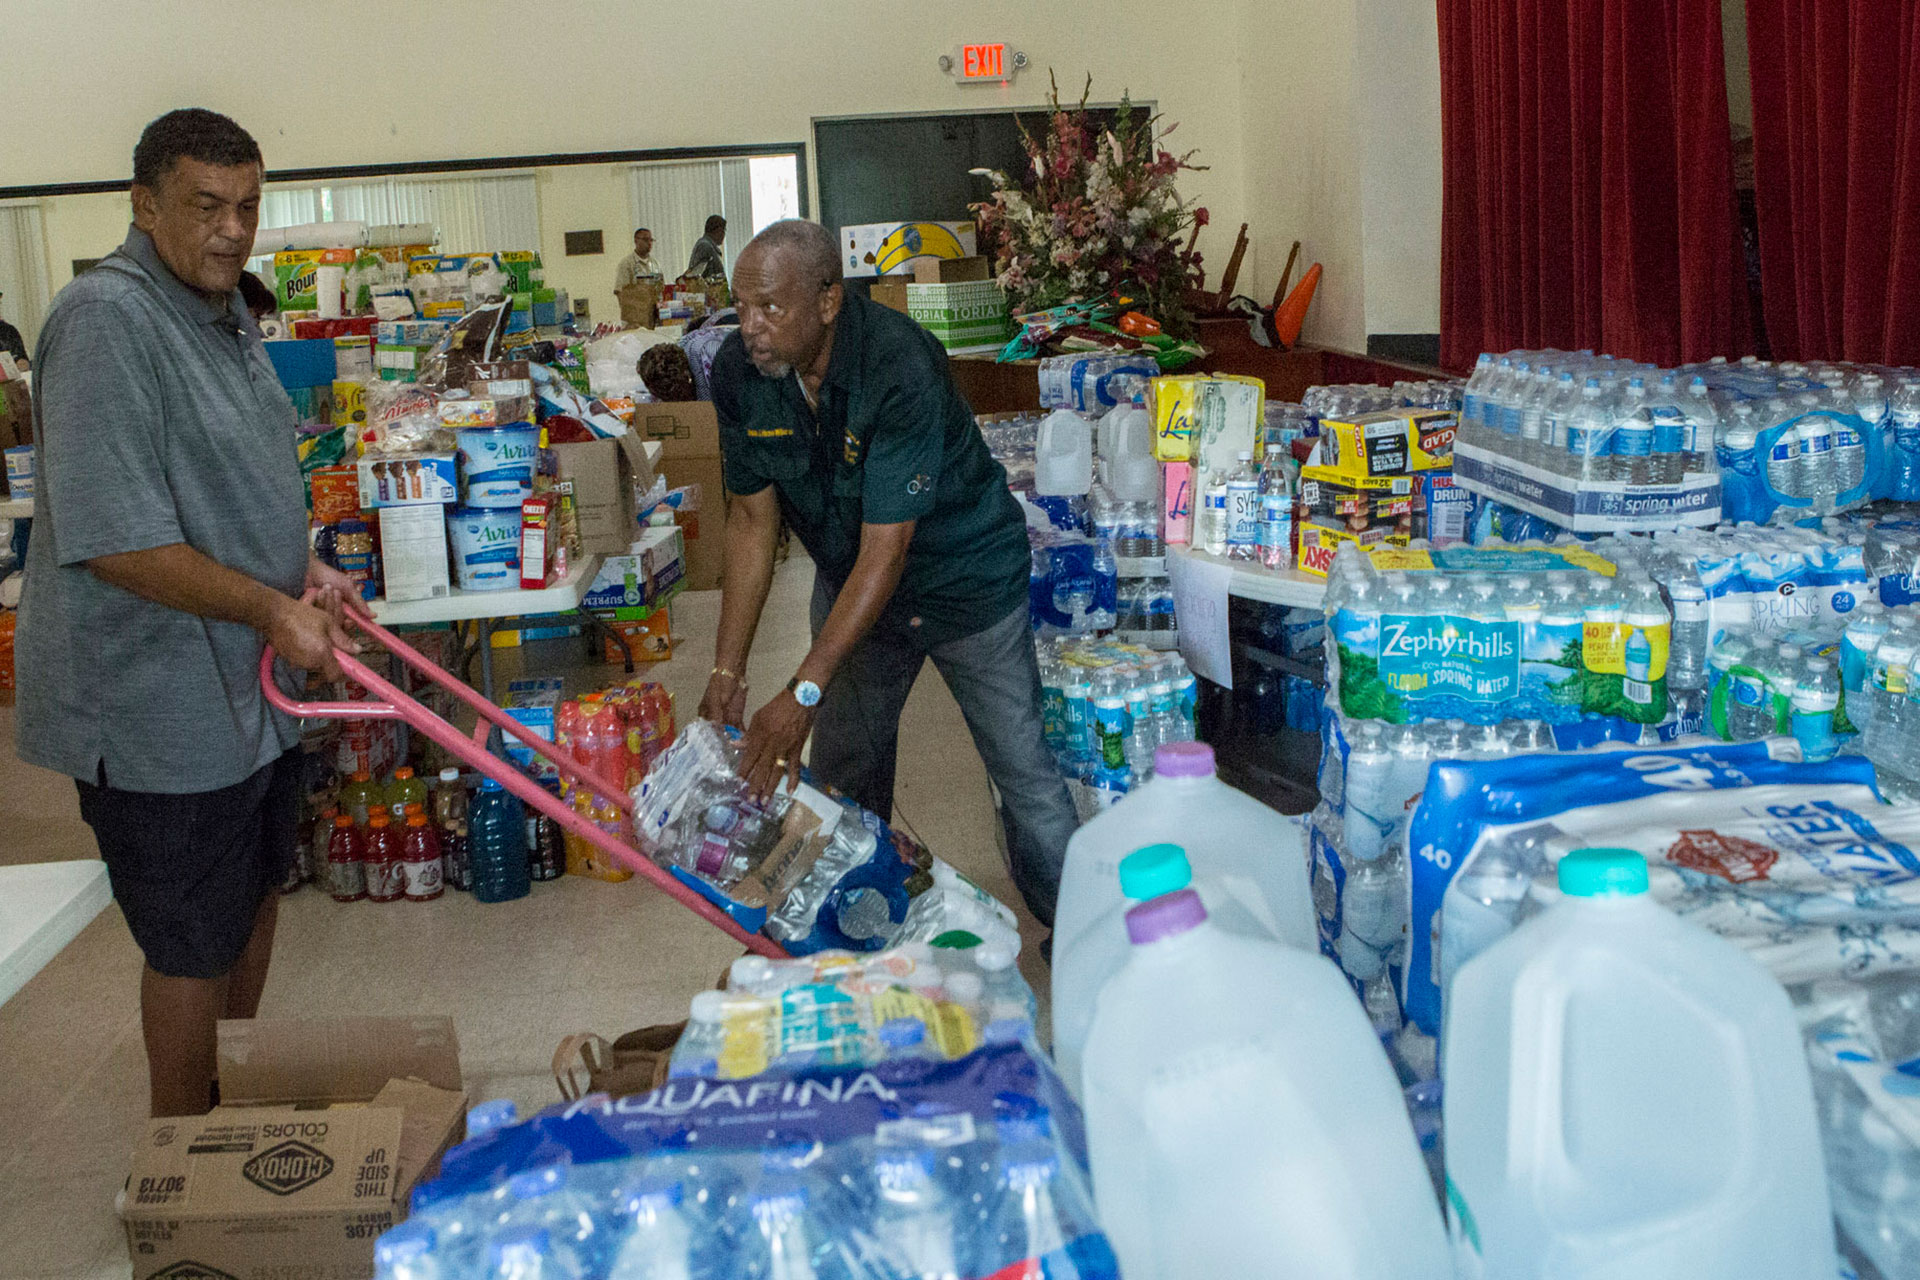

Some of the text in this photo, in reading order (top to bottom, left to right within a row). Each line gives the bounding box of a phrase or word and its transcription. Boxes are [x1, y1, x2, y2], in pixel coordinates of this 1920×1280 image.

[963, 43, 1005, 78] EXIT
[909, 309, 947, 320] TORIAL
[952, 304, 1003, 320] TORIAL
[1160, 400, 1192, 441] La
[1354, 425, 1364, 457] GLAD
[1422, 430, 1456, 450] GLAD
[1379, 479, 1391, 488] 32
[1433, 490, 1470, 501] DRUM
[1602, 500, 1619, 512] 365
[1624, 496, 1668, 516] spring
[1303, 546, 1338, 572] SKY
[1752, 594, 1820, 620] SPRING
[1835, 594, 1850, 604] 24
[1382, 621, 1513, 658] Zephyrhills
[1585, 626, 1599, 638] 40
[1388, 669, 1510, 694] FLORIDA SPRING WATER
[1622, 755, 1715, 791] 40
[1419, 843, 1452, 870] 40
[564, 1072, 892, 1118] AQUAFINA
[262, 1122, 329, 1138] COLORS
[365, 1148, 385, 1164] UP
[357, 1166, 389, 1181] SIDE
[354, 1183, 386, 1198] THIS
